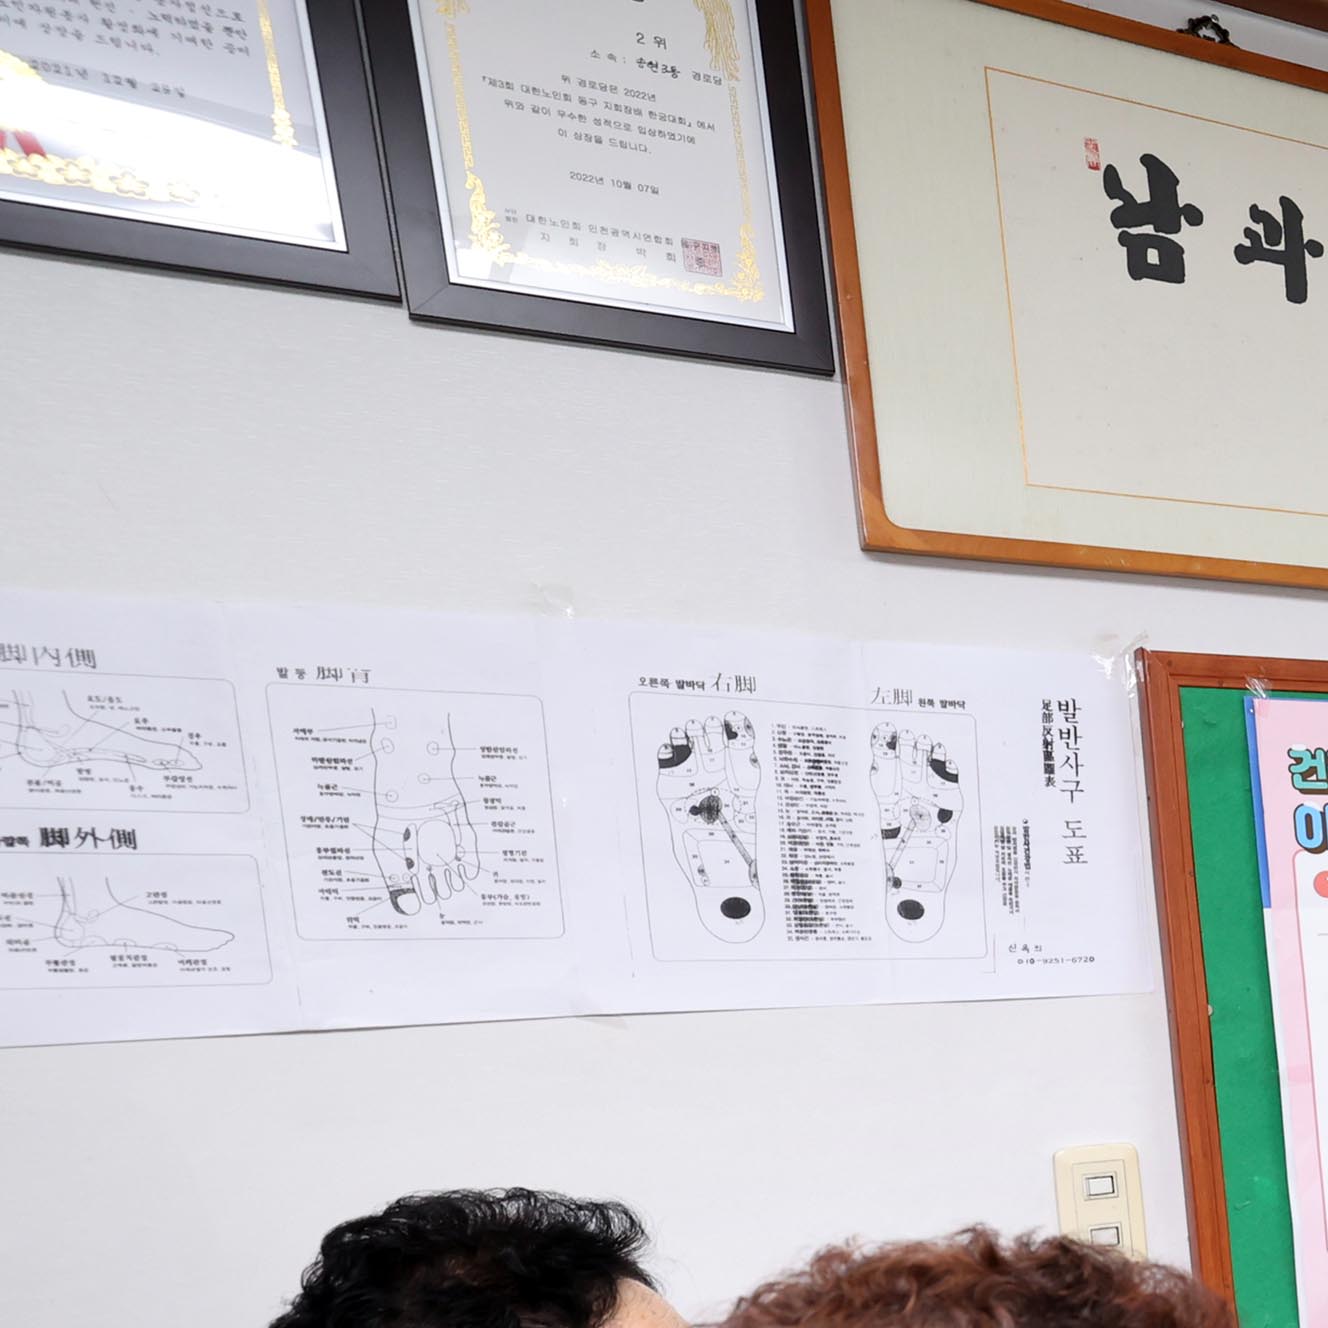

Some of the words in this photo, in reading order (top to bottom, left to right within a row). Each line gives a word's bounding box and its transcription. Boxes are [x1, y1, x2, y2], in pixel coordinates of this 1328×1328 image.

[561, 73, 571, 84] 위
[577, 77, 618, 95] 경로당은
[623, 87, 656, 103] 2022년
[503, 98, 524, 111] 위와
[530, 103, 551, 116] 같이
[557, 108, 587, 124] 우수한
[592, 115, 632, 132] 성적으로
[520, 83, 572, 103] 대한노인회
[577, 95, 597, 108] 동구
[603, 100, 643, 117] 지회장배
[696, 119, 715, 132] 에서
[557, 127, 567, 138] 이
[573, 130, 603, 145] 상장을
[608, 137, 651, 154] 드립니다.
[569, 170, 604, 185] 2022년
[611, 178, 632, 190] 10월
[637, 182, 659, 195] 07일
